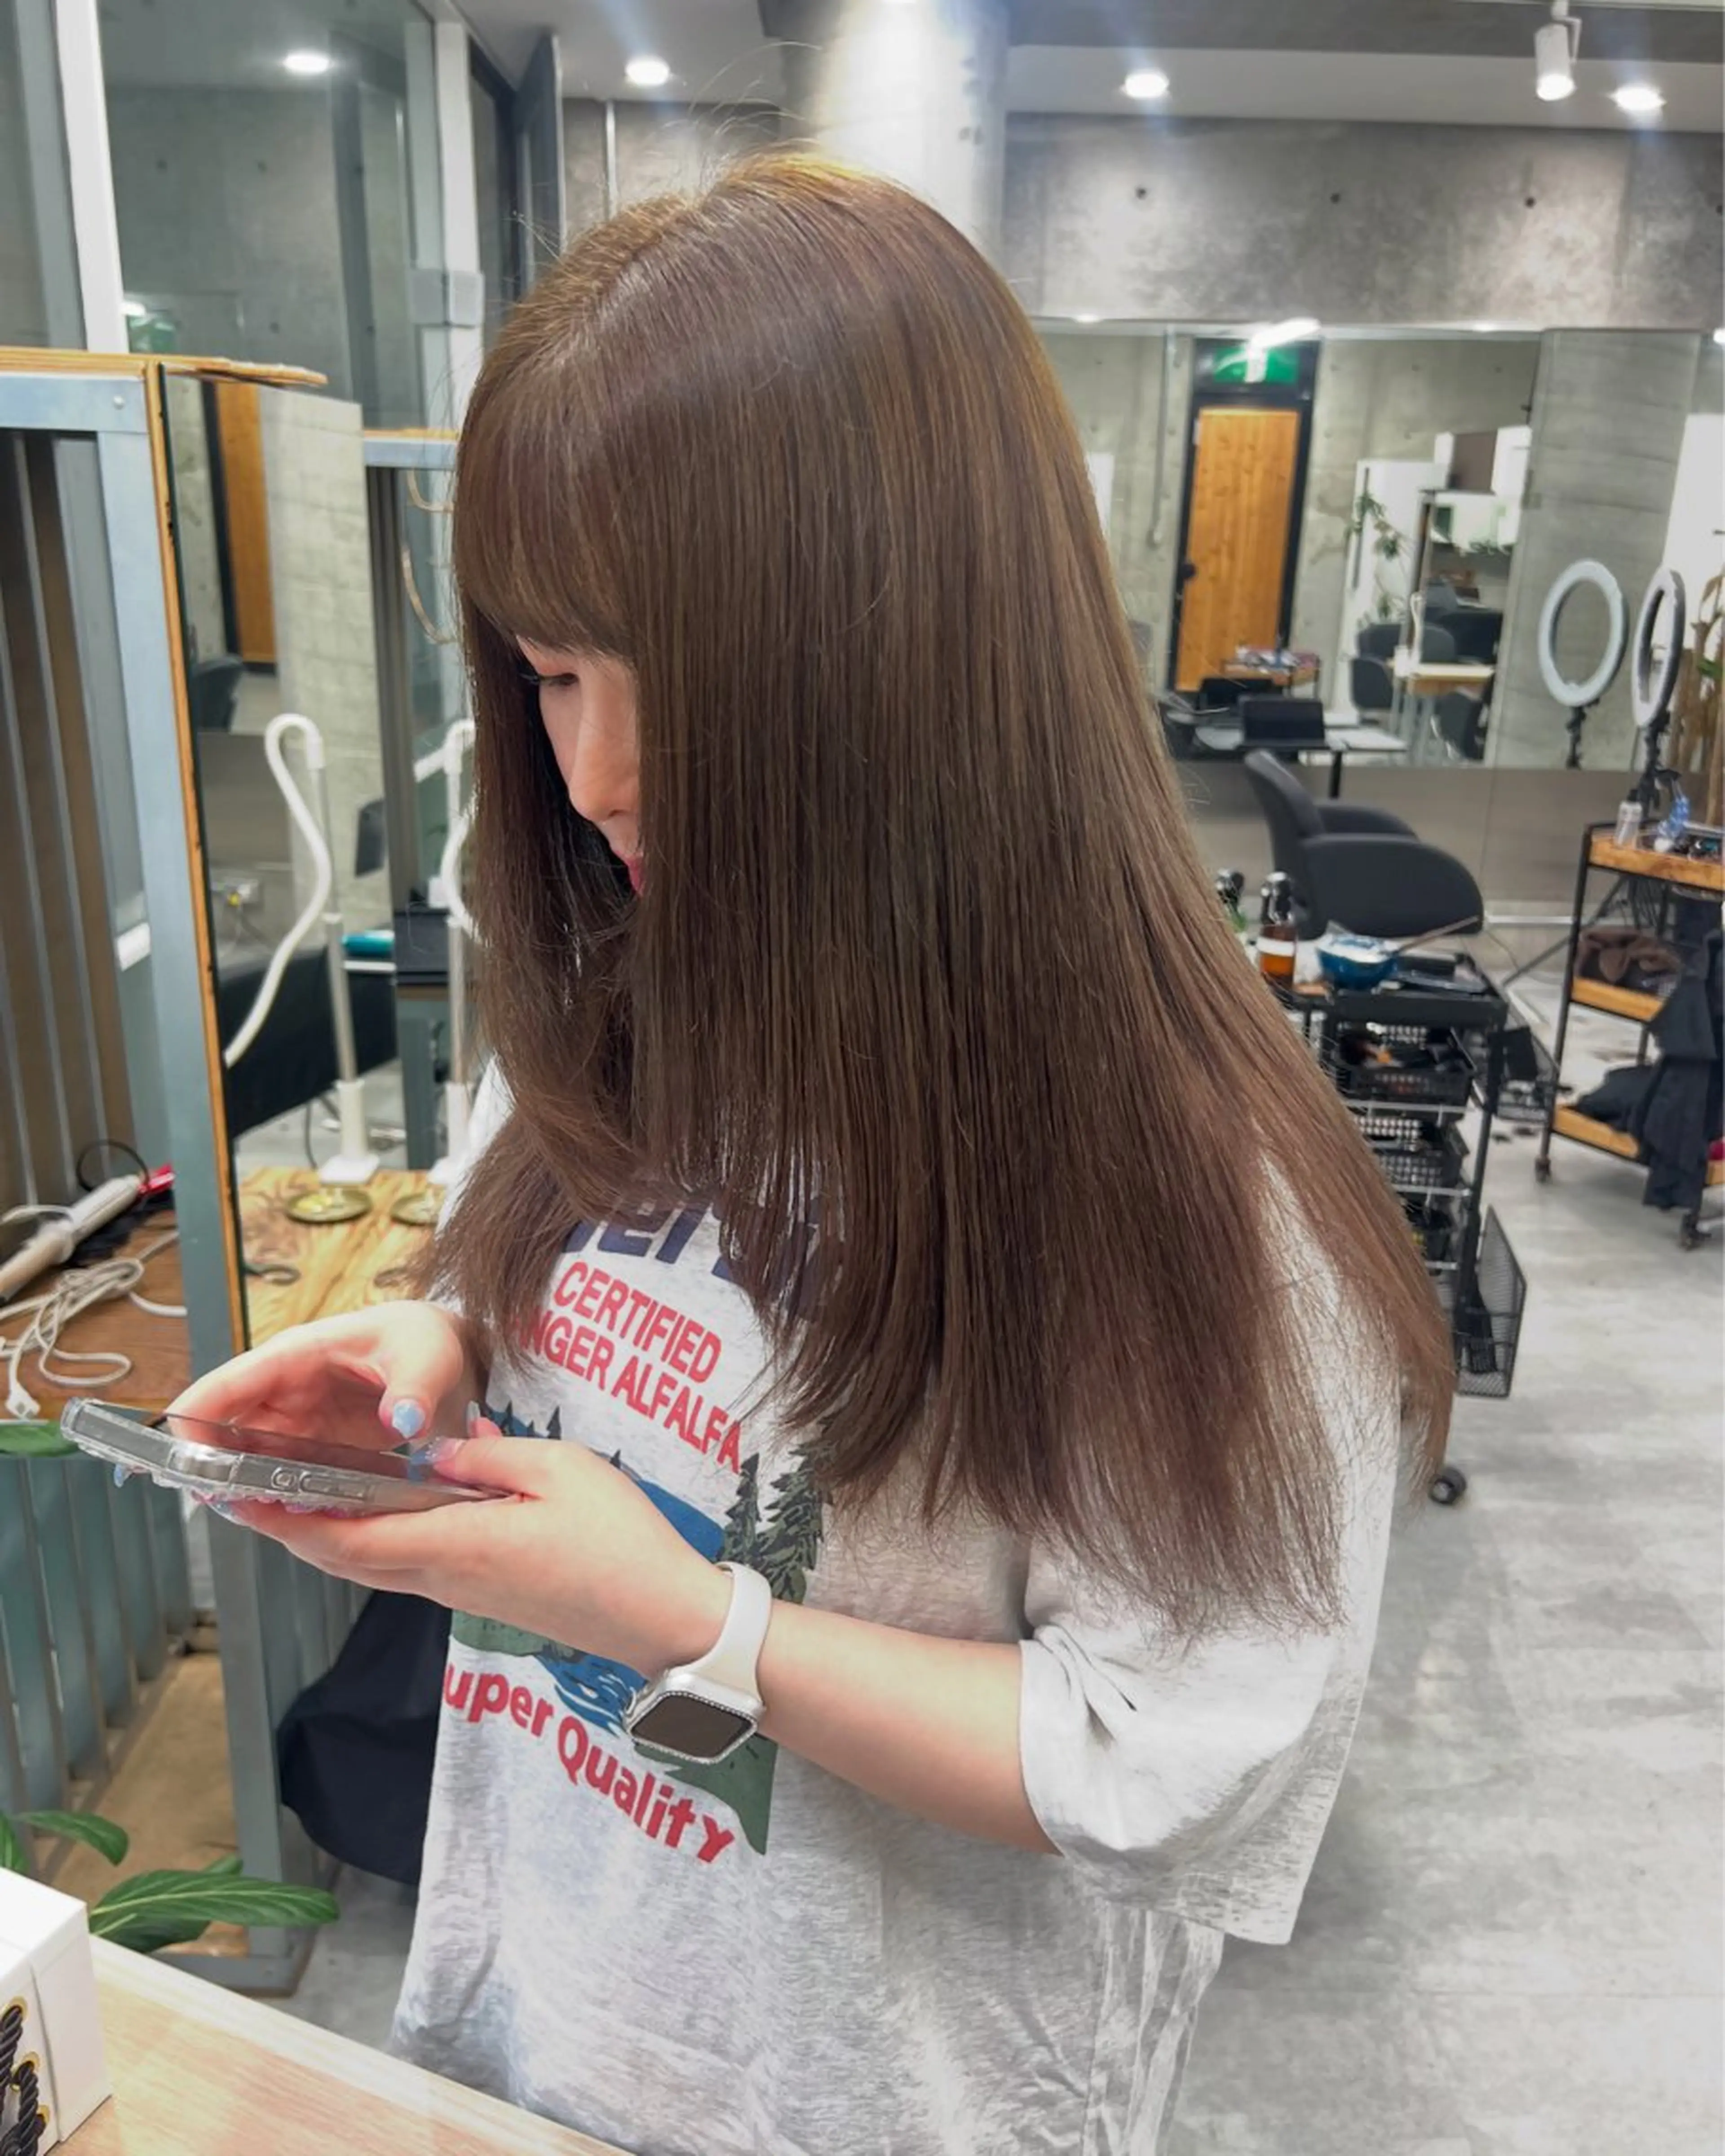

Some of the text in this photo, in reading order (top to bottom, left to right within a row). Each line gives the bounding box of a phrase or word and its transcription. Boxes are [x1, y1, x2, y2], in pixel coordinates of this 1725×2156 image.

[553, 1261, 721, 1383] CERTIFIED
[610, 1355, 740, 1474] ALFALFA
[558, 1715, 735, 1863] Quality
